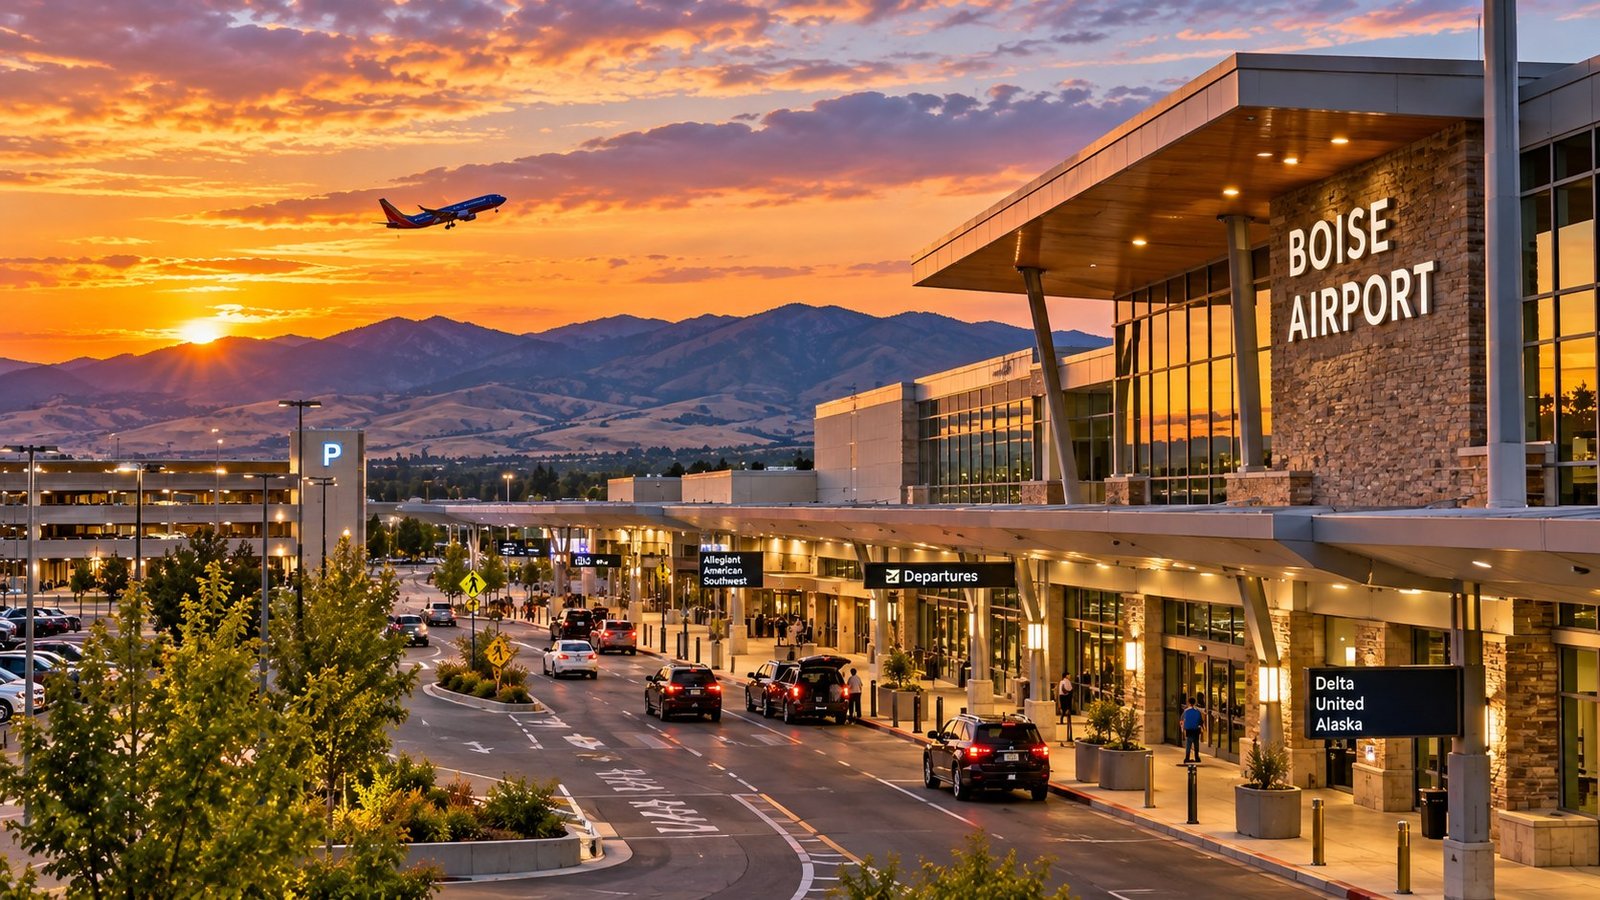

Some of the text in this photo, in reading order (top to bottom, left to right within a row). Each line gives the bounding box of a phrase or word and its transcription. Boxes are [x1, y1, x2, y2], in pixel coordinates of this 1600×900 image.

[1289, 197, 1389, 277] BOISE
[1288, 260, 1434, 342] AIRPORT
[323, 443, 342, 466] P
[703, 555, 741, 566] Allegiant
[703, 566, 743, 575] American
[904, 570, 978, 585] Departures
[703, 576, 748, 585] Southwest
[1315, 675, 1355, 691] Delta
[1315, 696, 1365, 711] United
[1315, 717, 1363, 732] Alaska
